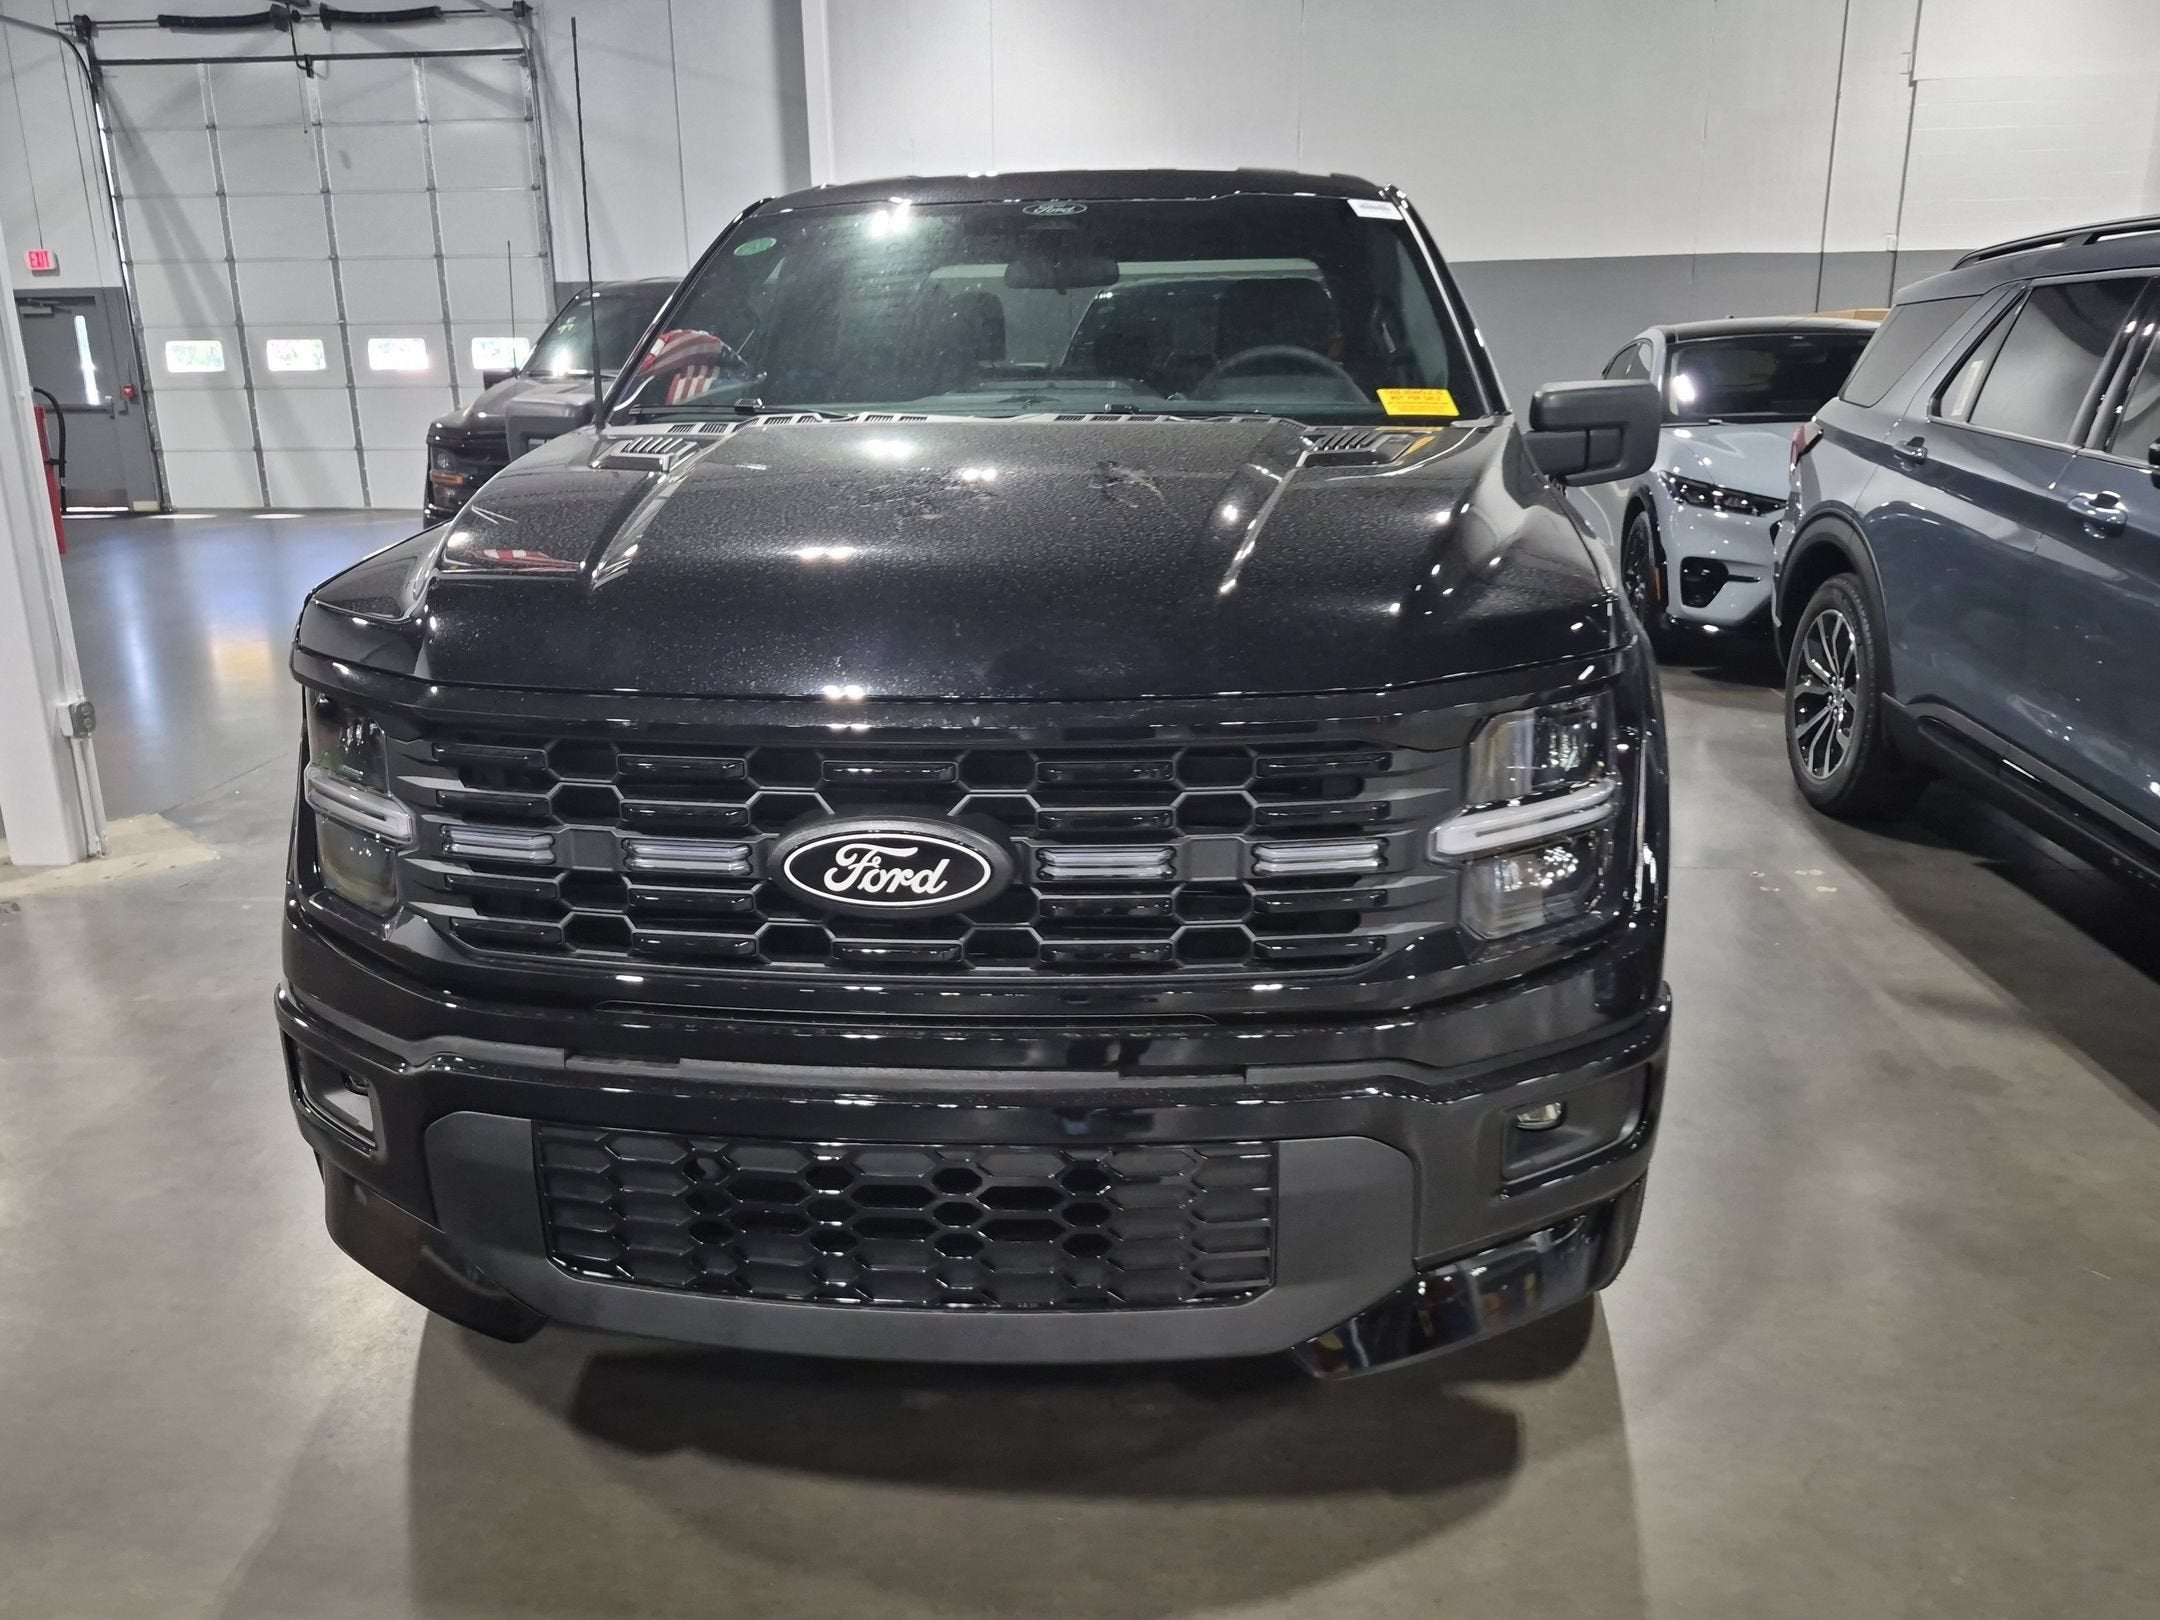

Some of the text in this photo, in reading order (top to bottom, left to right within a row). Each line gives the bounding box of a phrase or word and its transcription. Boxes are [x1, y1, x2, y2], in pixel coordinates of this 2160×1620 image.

[1033, 203, 1076, 214] Ford
[28, 251, 50, 268] EXIT
[823, 843, 951, 894] Ford
